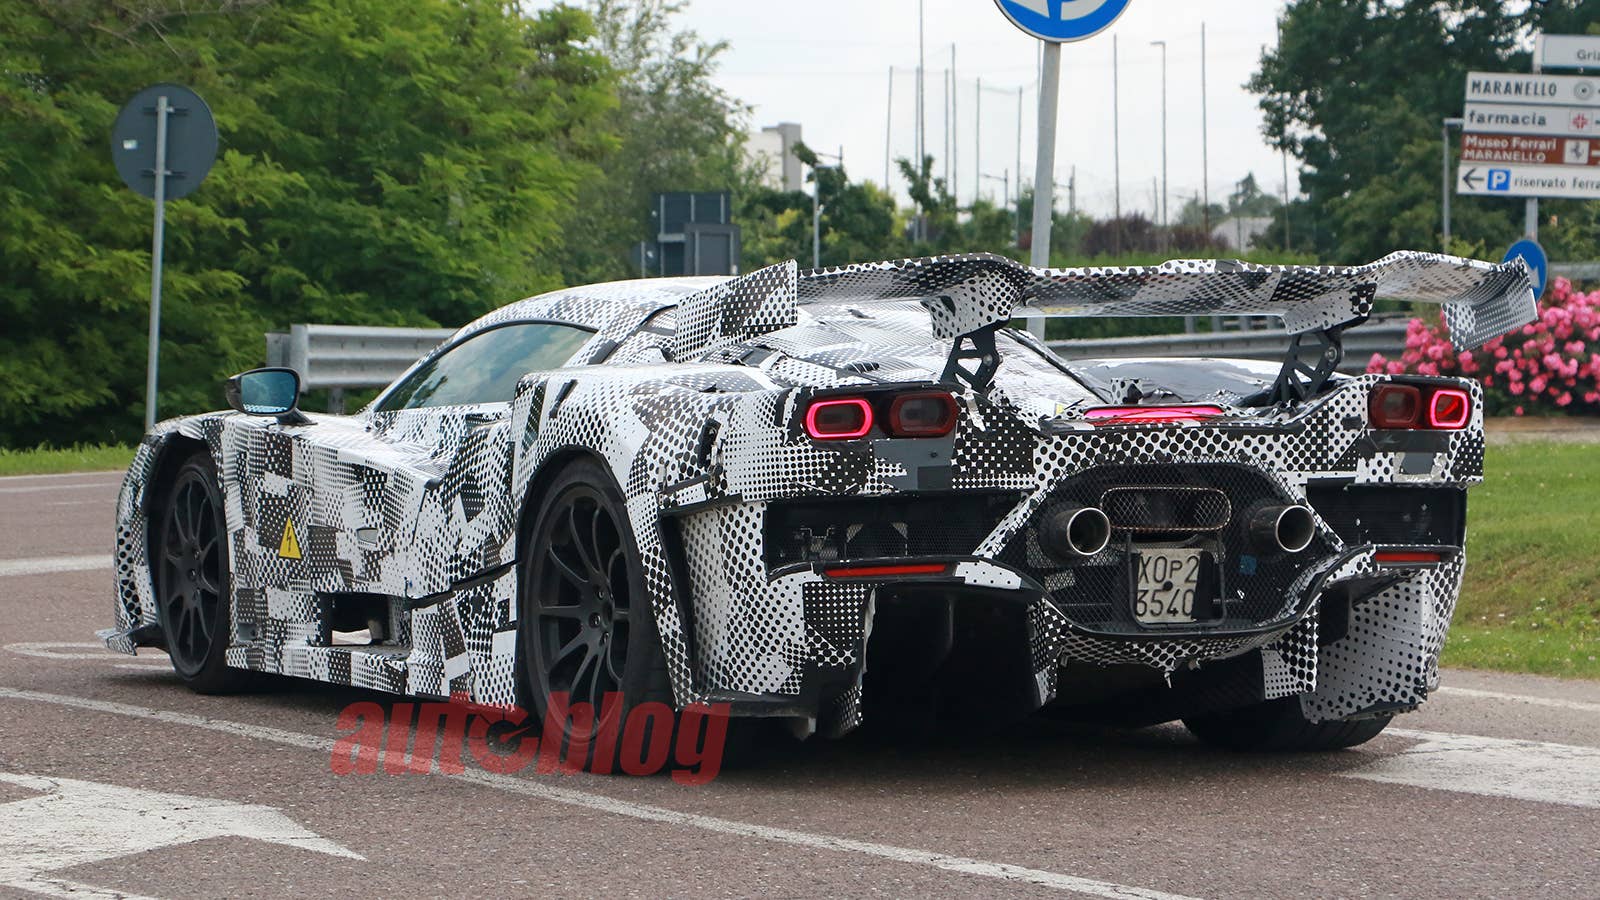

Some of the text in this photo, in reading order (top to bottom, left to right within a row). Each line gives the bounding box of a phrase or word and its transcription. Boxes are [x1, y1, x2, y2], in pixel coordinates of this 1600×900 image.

[1472, 79, 1557, 96] MARANELLO
[1469, 110, 1547, 126] farmacia
[1466, 136, 1556, 150] Museo Ferrari
[1464, 149, 1546, 162] MARANELLO
[1493, 171, 1507, 189] P
[1514, 176, 1566, 188] riservato
[1136, 588, 1195, 617] 3540
